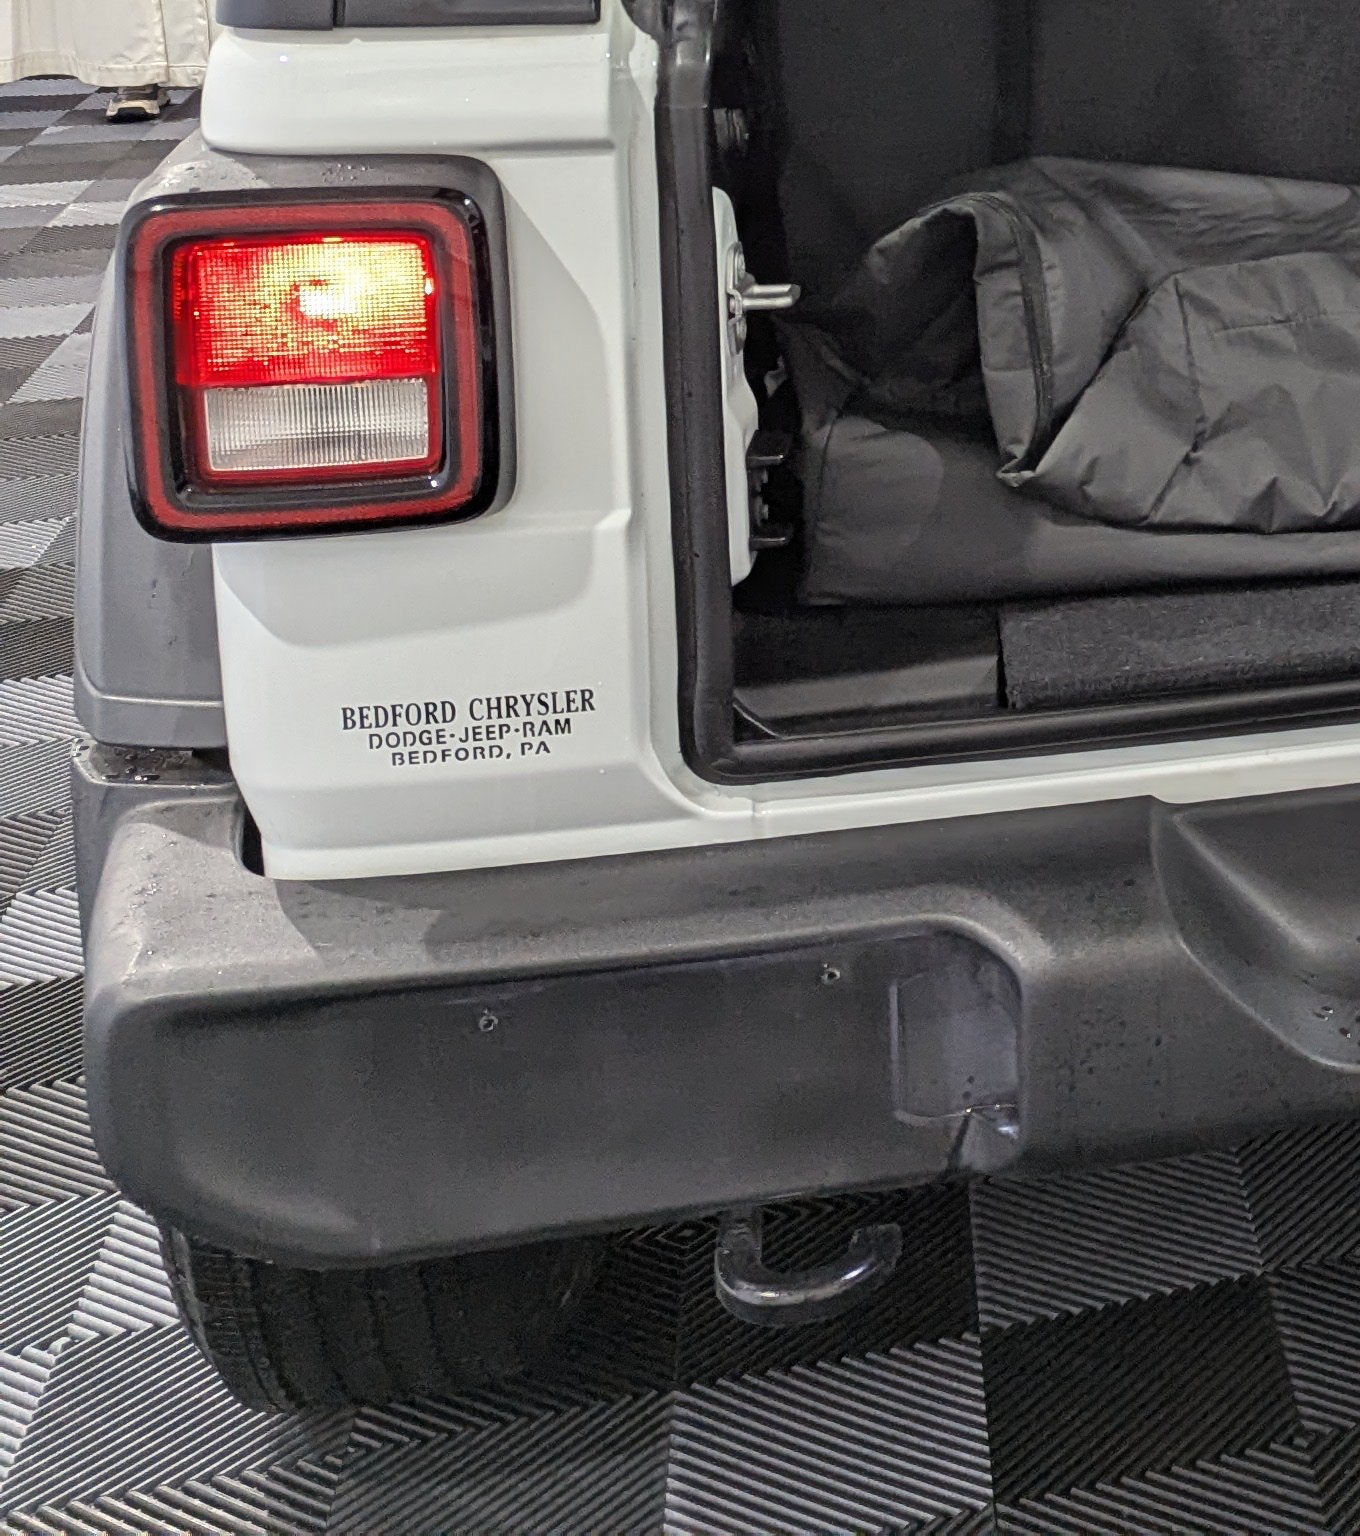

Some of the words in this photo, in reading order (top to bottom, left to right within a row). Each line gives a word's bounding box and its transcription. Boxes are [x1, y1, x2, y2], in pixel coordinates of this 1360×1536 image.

[341, 700, 456, 730] BEDFORD
[469, 688, 595, 721] CHRYSLER
[391, 744, 512, 766] BEDFORD,
[521, 740, 550, 756] PA
